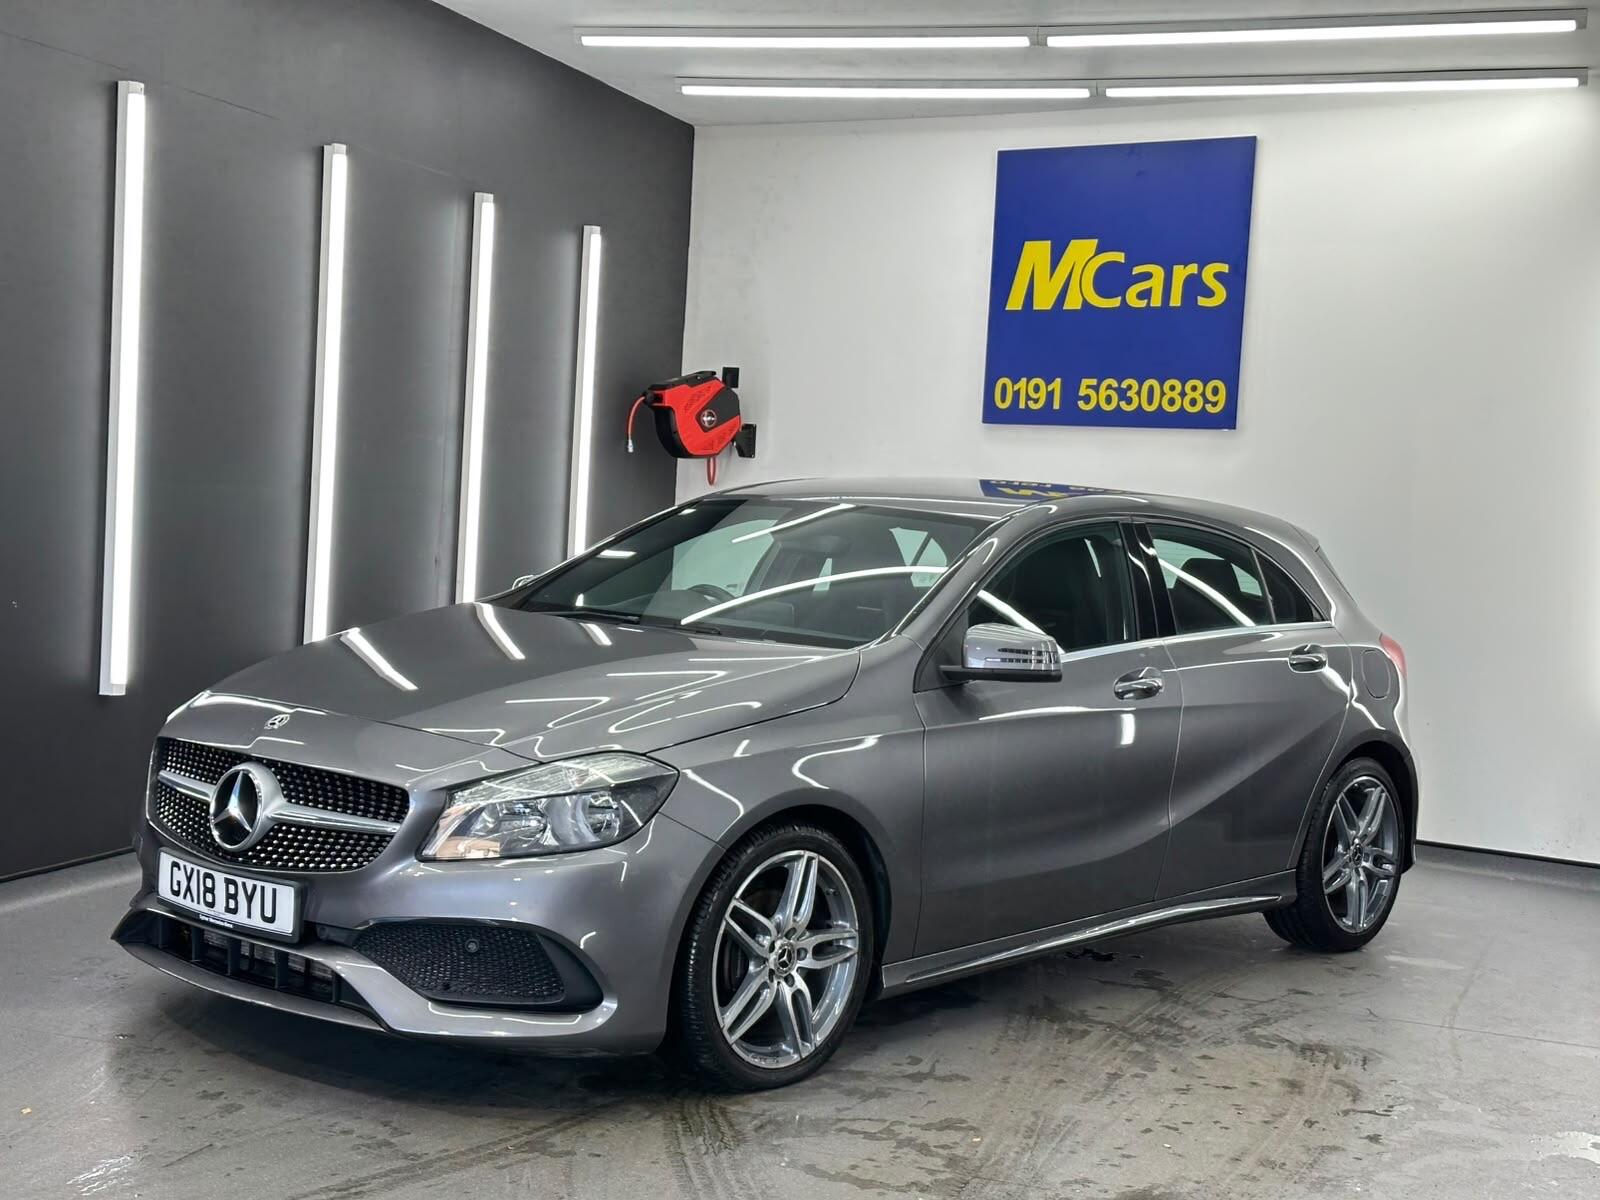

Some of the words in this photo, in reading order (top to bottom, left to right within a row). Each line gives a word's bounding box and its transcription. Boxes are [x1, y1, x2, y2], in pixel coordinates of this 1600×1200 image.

[994, 377, 1062, 410] 0191
[1077, 378, 1227, 414] 5630889
[170, 861, 216, 909] GX18
[223, 876, 277, 924] BYU
